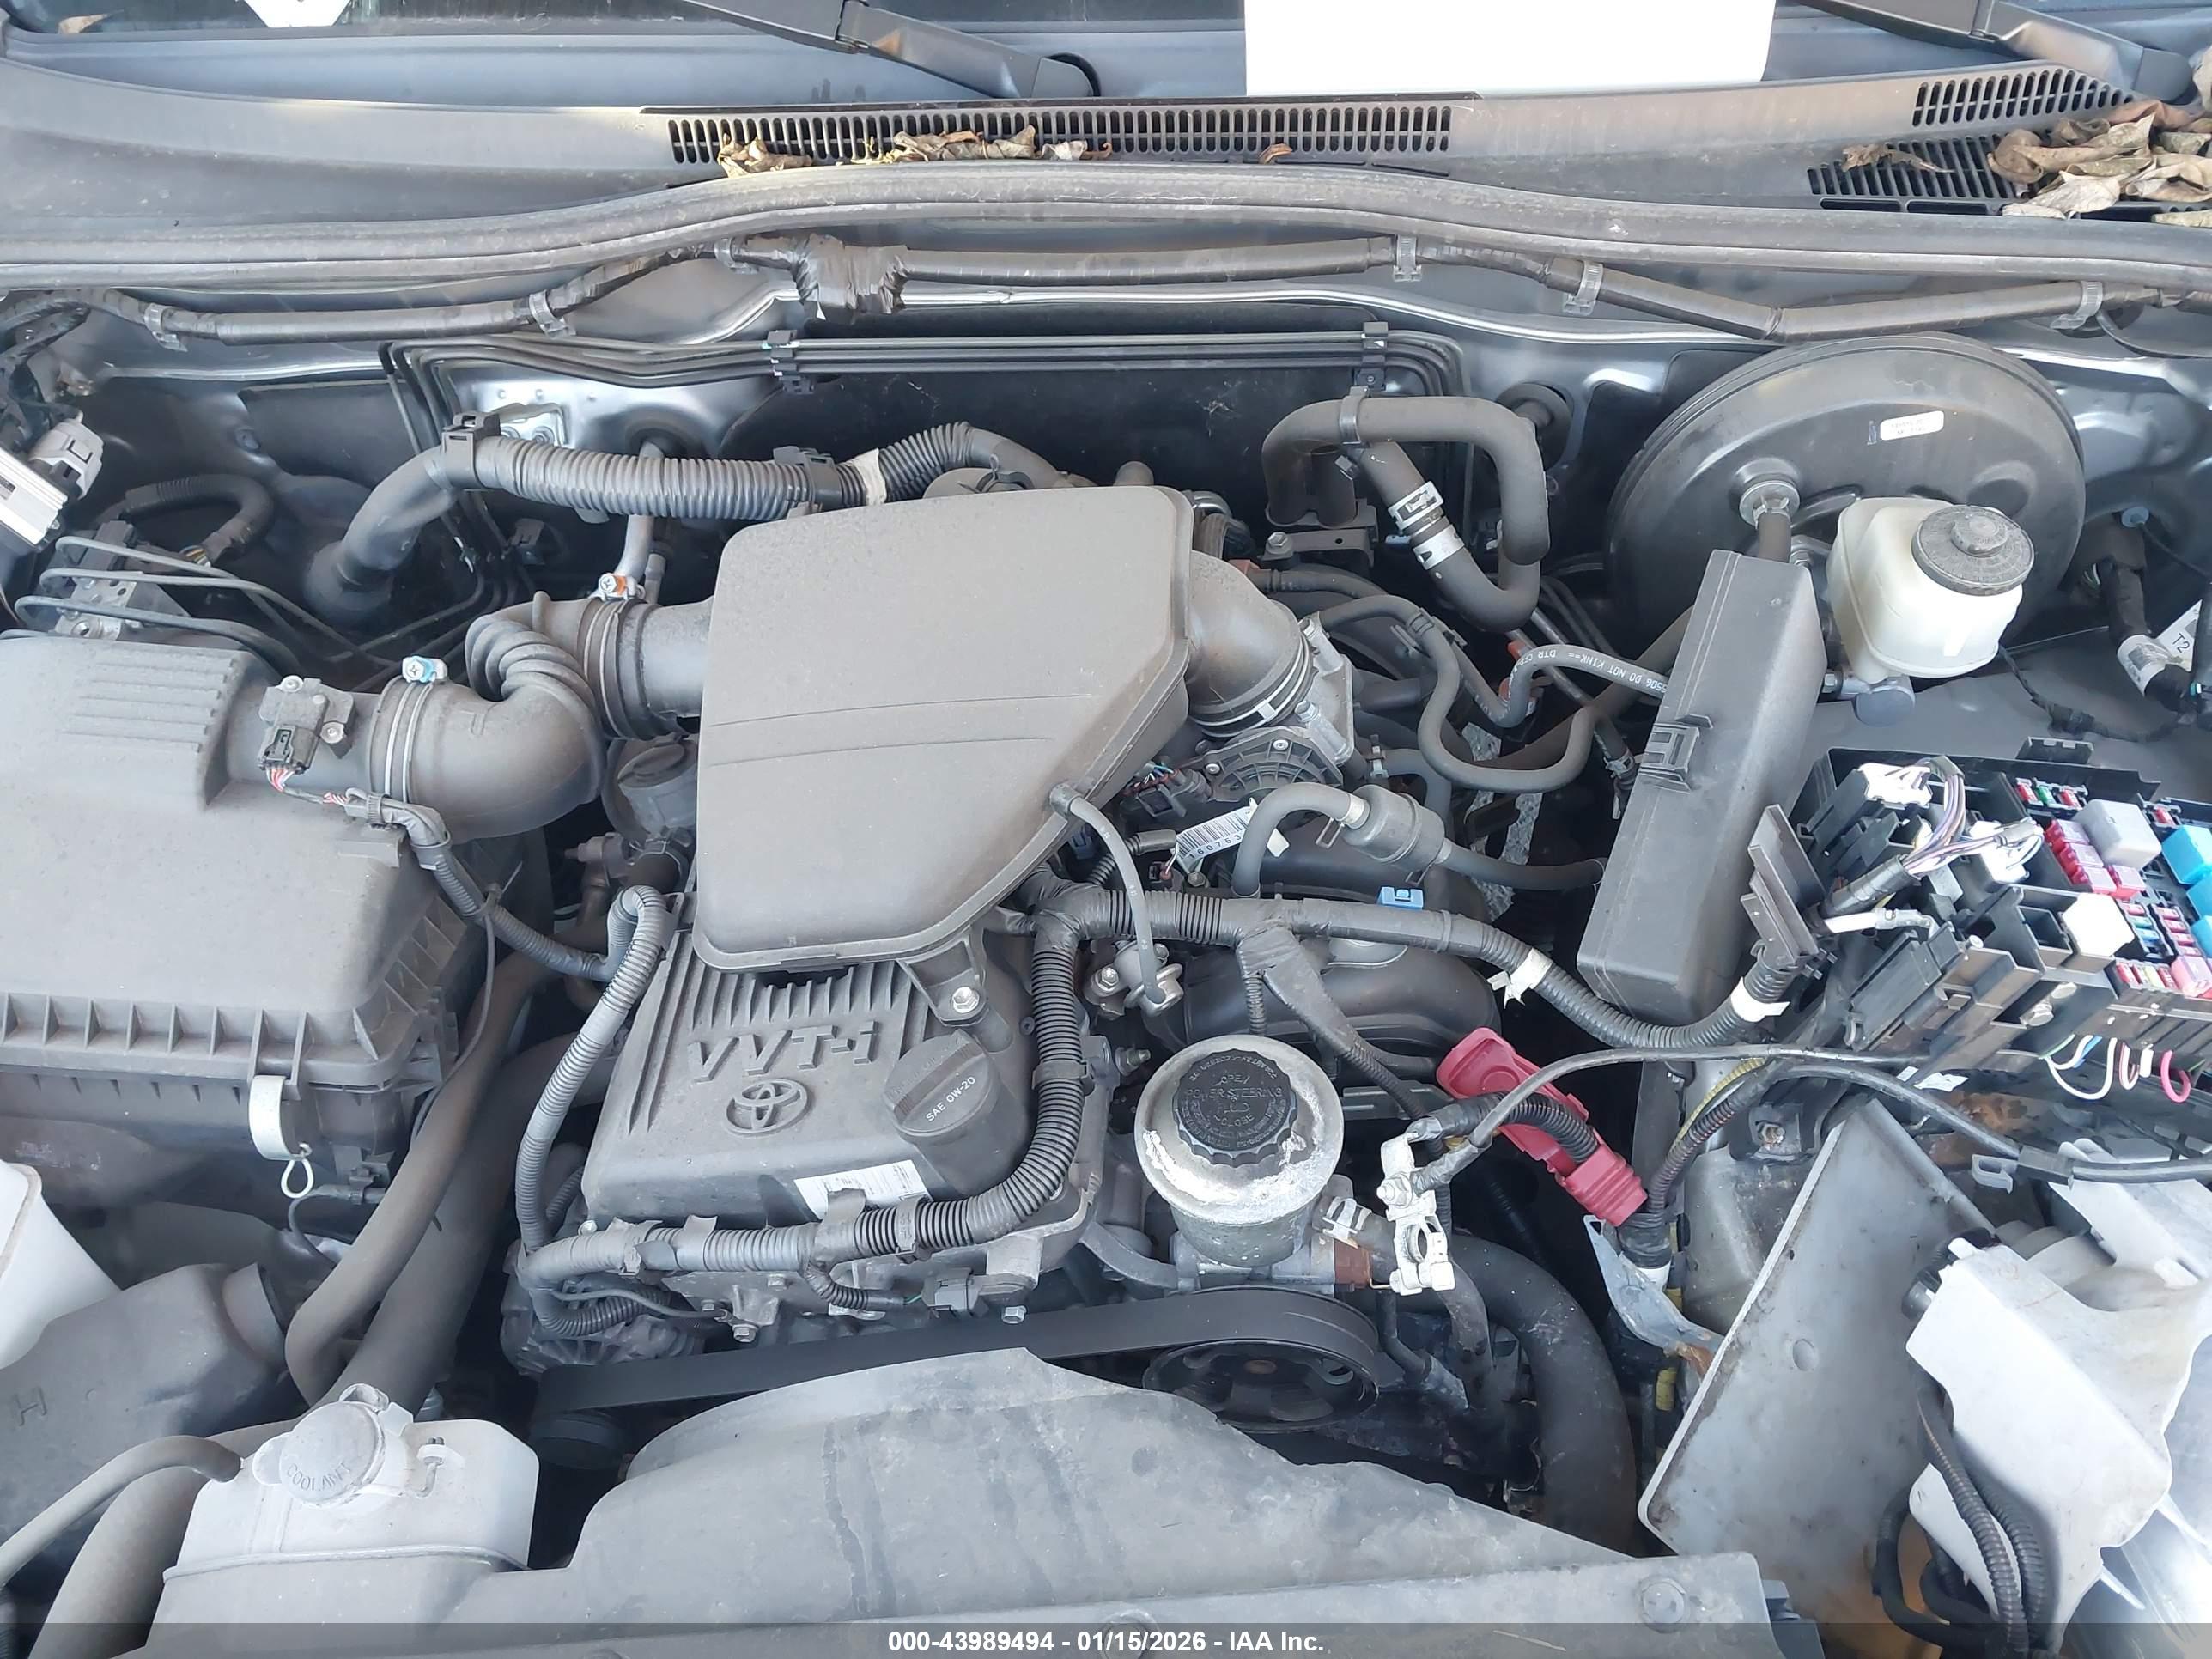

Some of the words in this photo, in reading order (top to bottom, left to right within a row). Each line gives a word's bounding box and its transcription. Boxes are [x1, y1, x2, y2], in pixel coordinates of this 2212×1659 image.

[1537, 649, 1557, 659] DTR
[2172, 632, 2191, 653] T2
[1607, 665, 1626, 678] NOT
[1629, 672, 1642, 684] DO
[1188, 834, 1243, 859] 160753
[687, 1019, 878, 1084] VVT-i
[926, 1103, 946, 1121] SAE
[946, 1076, 976, 1103] 0W-20
[287, 1461, 351, 1492] COOLANT
